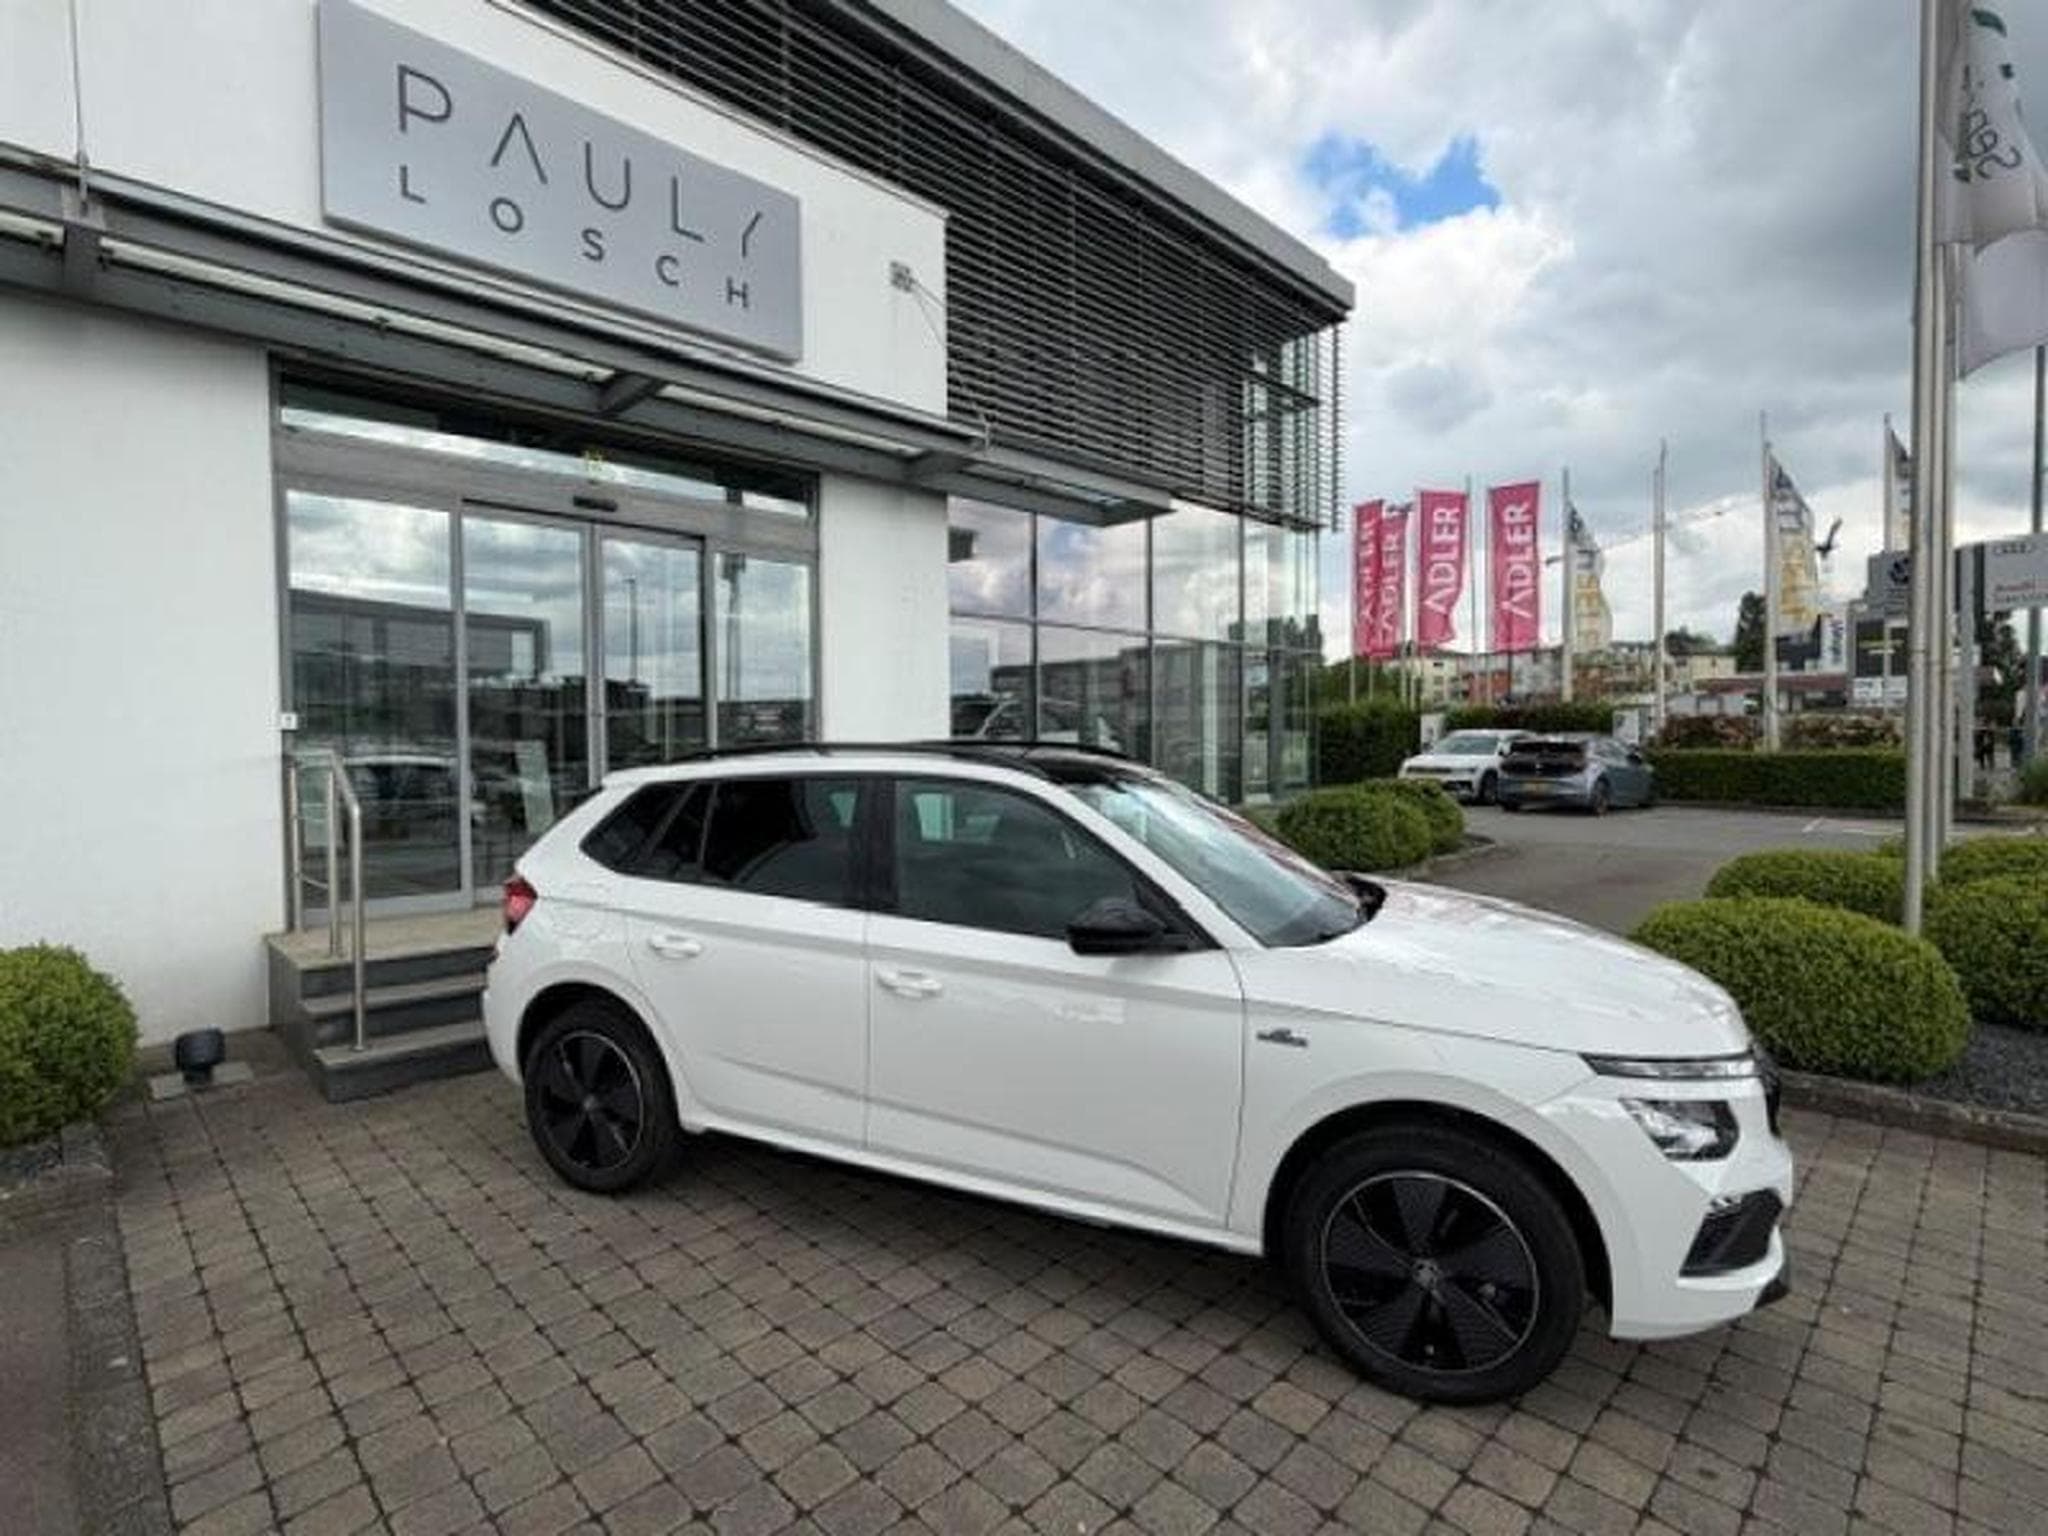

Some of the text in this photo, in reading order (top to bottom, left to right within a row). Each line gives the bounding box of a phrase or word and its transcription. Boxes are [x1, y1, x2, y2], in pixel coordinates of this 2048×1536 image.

[400, 164, 750, 308] LOSCH
[1381, 532, 1400, 631] ADLER
[1423, 506, 1461, 615] ADLER
[1501, 502, 1535, 619] ADLER
